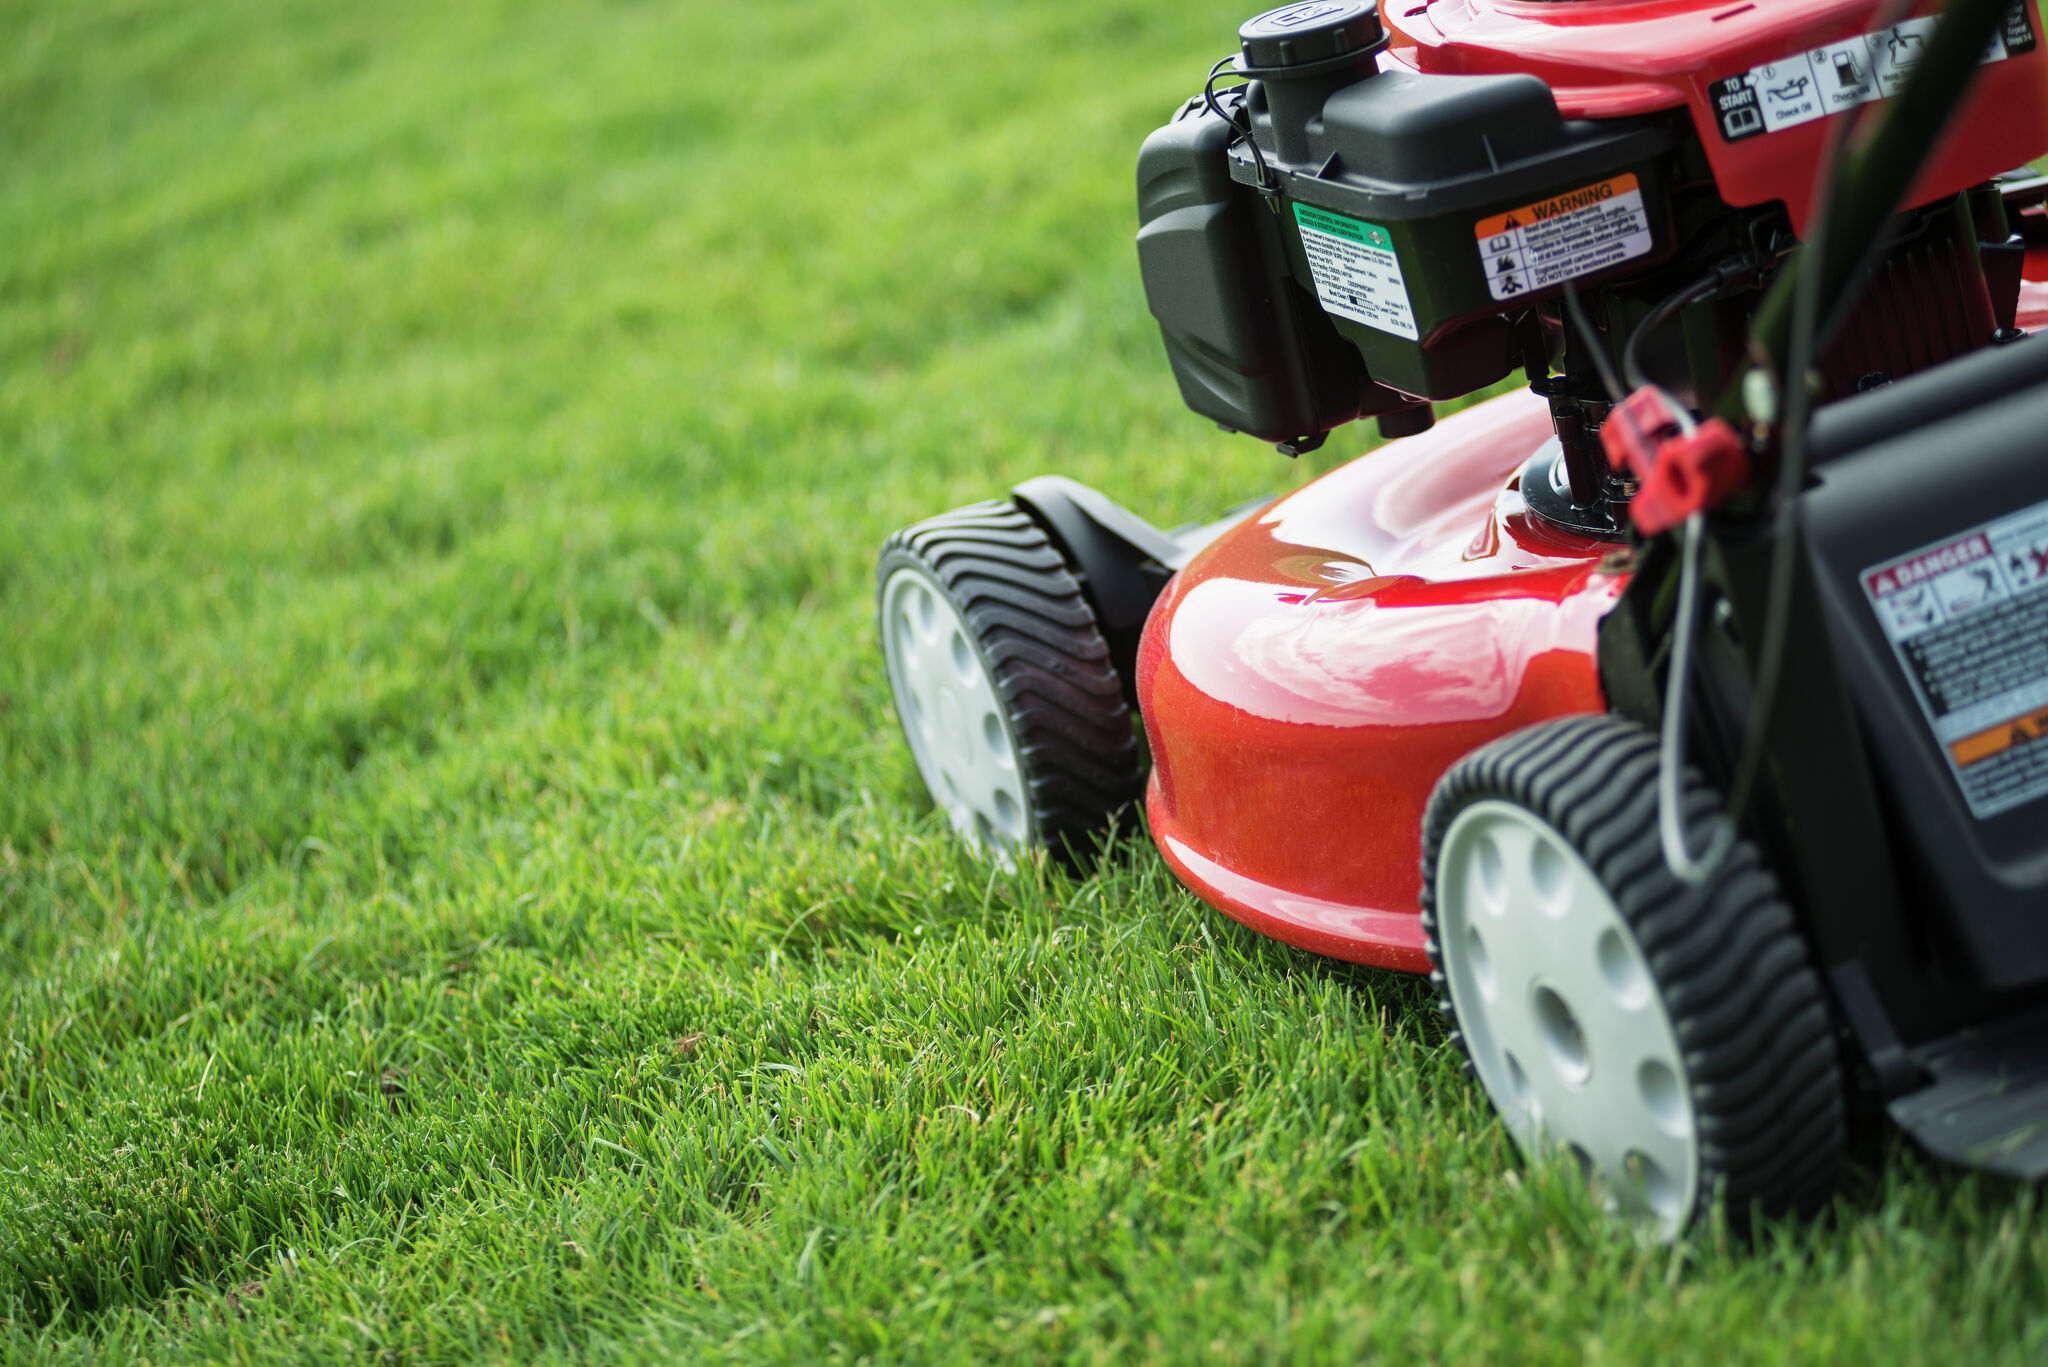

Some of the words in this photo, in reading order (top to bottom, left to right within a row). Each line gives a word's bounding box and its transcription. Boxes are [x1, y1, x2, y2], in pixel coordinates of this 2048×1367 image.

[1724, 78, 1740, 92] TO
[1720, 91, 1753, 110] START
[1832, 89, 1856, 103] Check
[1776, 107, 1800, 120] Check
[1801, 103, 1812, 113] Oil
[1532, 183, 1613, 220] WARNING
[1562, 221, 1581, 232] before
[1582, 213, 1605, 226] running
[1610, 216, 1629, 228] engine
[1594, 232, 1613, 244] before
[1535, 264, 1559, 276] Engines
[1574, 252, 1594, 263] carbon
[1536, 276, 1547, 285] DO
[1548, 270, 1562, 280] NOT
[1896, 536, 1986, 585] DANGER
